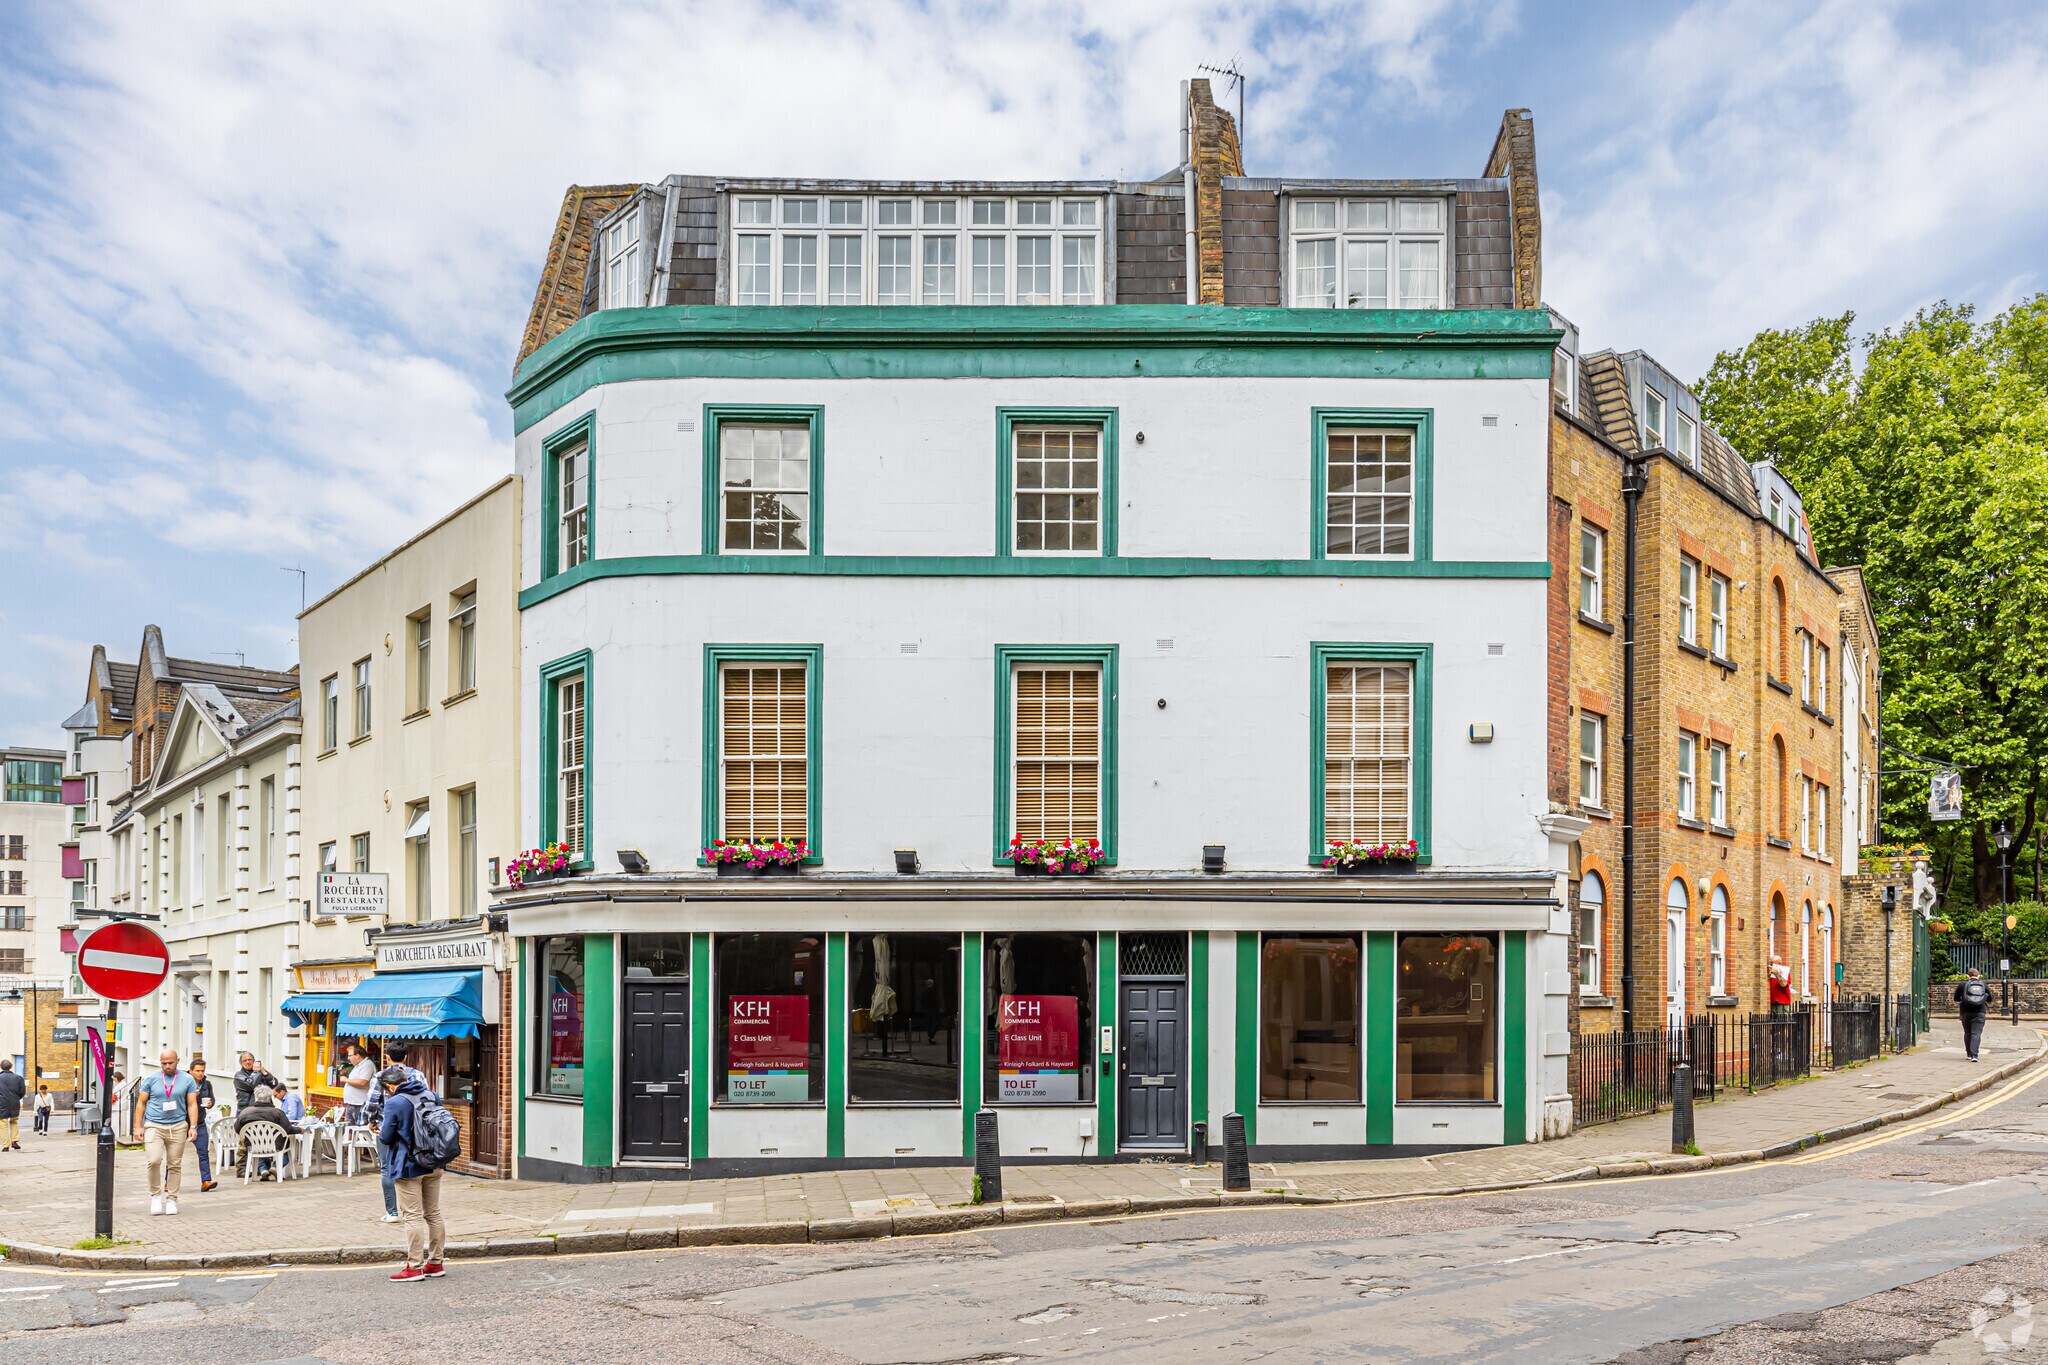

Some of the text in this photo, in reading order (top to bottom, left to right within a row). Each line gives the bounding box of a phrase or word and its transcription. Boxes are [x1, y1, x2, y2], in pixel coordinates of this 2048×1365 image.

[348, 876, 360, 885] LA
[324, 885, 384, 895] ROCCHETTA
[385, 942, 487, 962] LA ROCCHETTA RESTAURANT
[652, 949, 664, 959] 41
[347, 1003, 433, 1018] RISTORANTE ITALIANO
[552, 998, 568, 1013] KFH
[733, 1001, 770, 1017] KFH
[1004, 1000, 1040, 1016] KFH
[734, 1034, 772, 1042] E Class Unit
[733, 1080, 766, 1089] TO LET
[1004, 1080, 1037, 1089] TO LET
